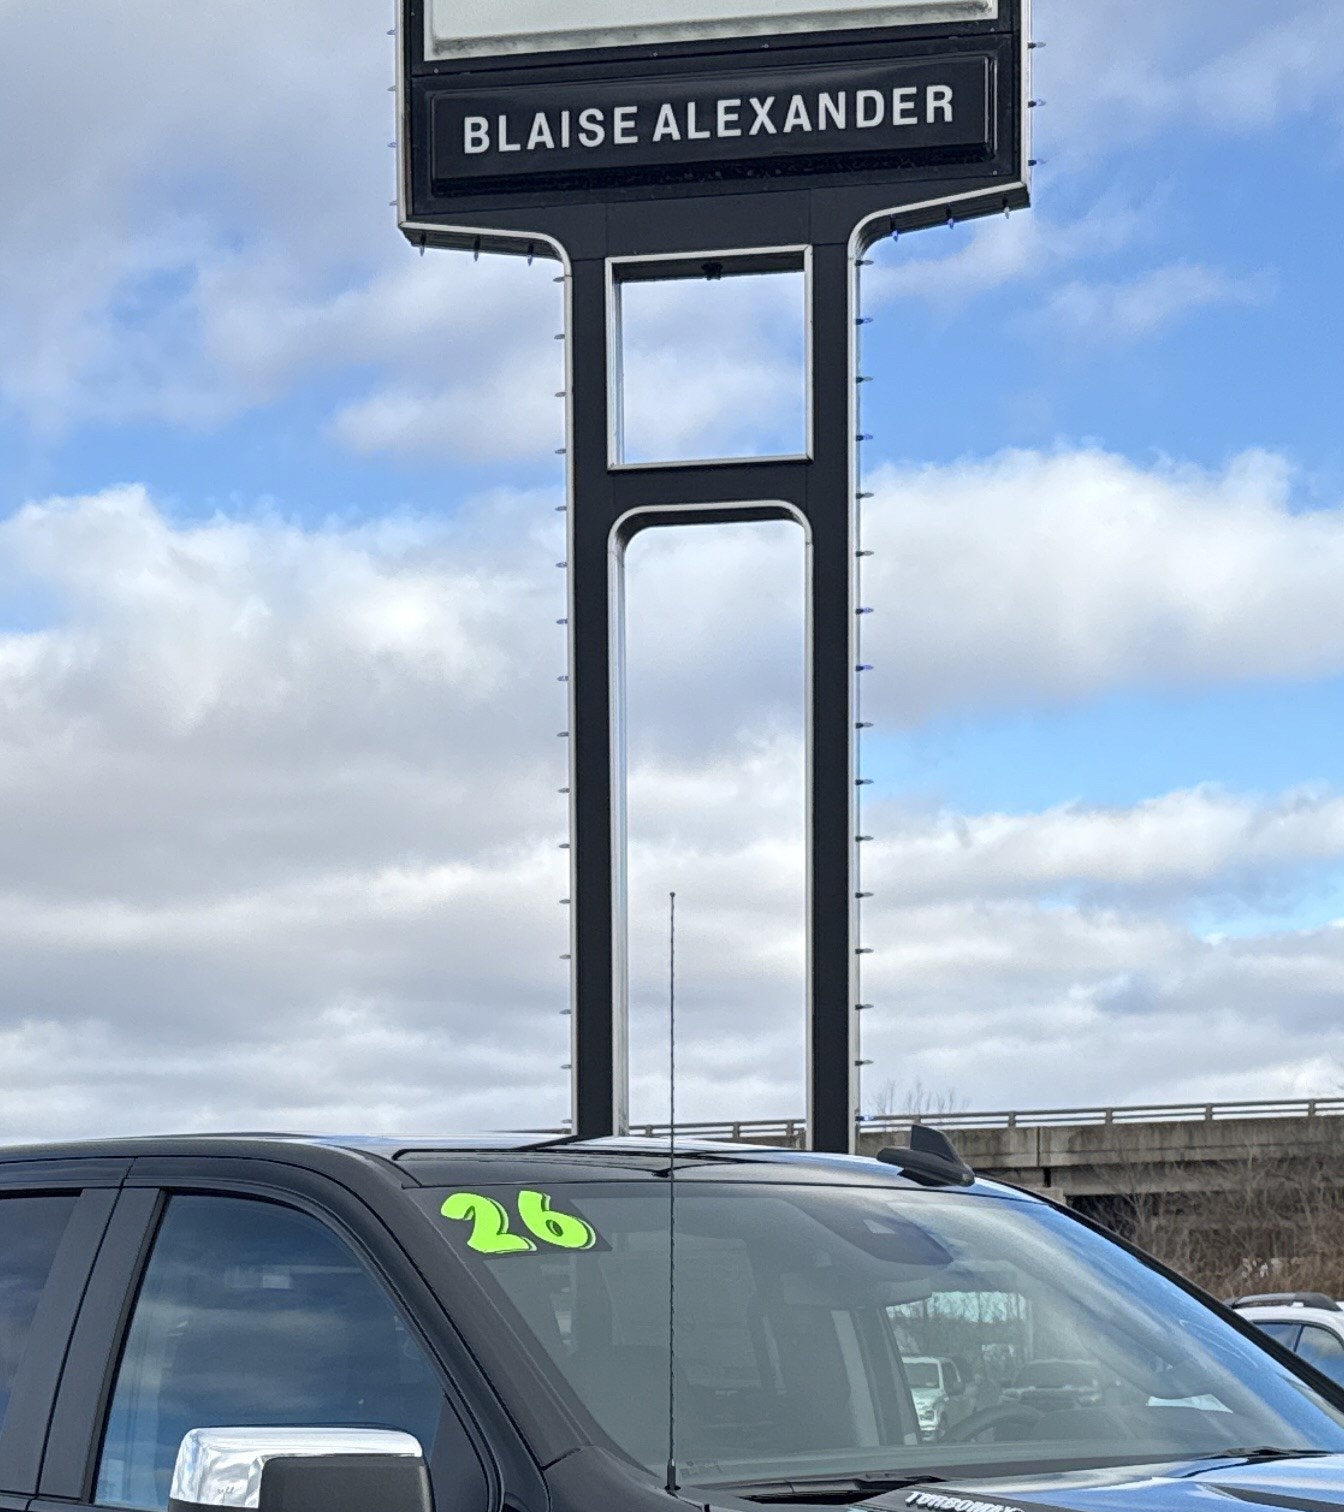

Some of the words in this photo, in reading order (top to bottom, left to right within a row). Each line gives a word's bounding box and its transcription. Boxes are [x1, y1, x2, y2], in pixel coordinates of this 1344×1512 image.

[463, 105, 639, 154] BLAISE
[652, 84, 955, 143] ALEXANDER
[440, 1190, 597, 1255] 26
